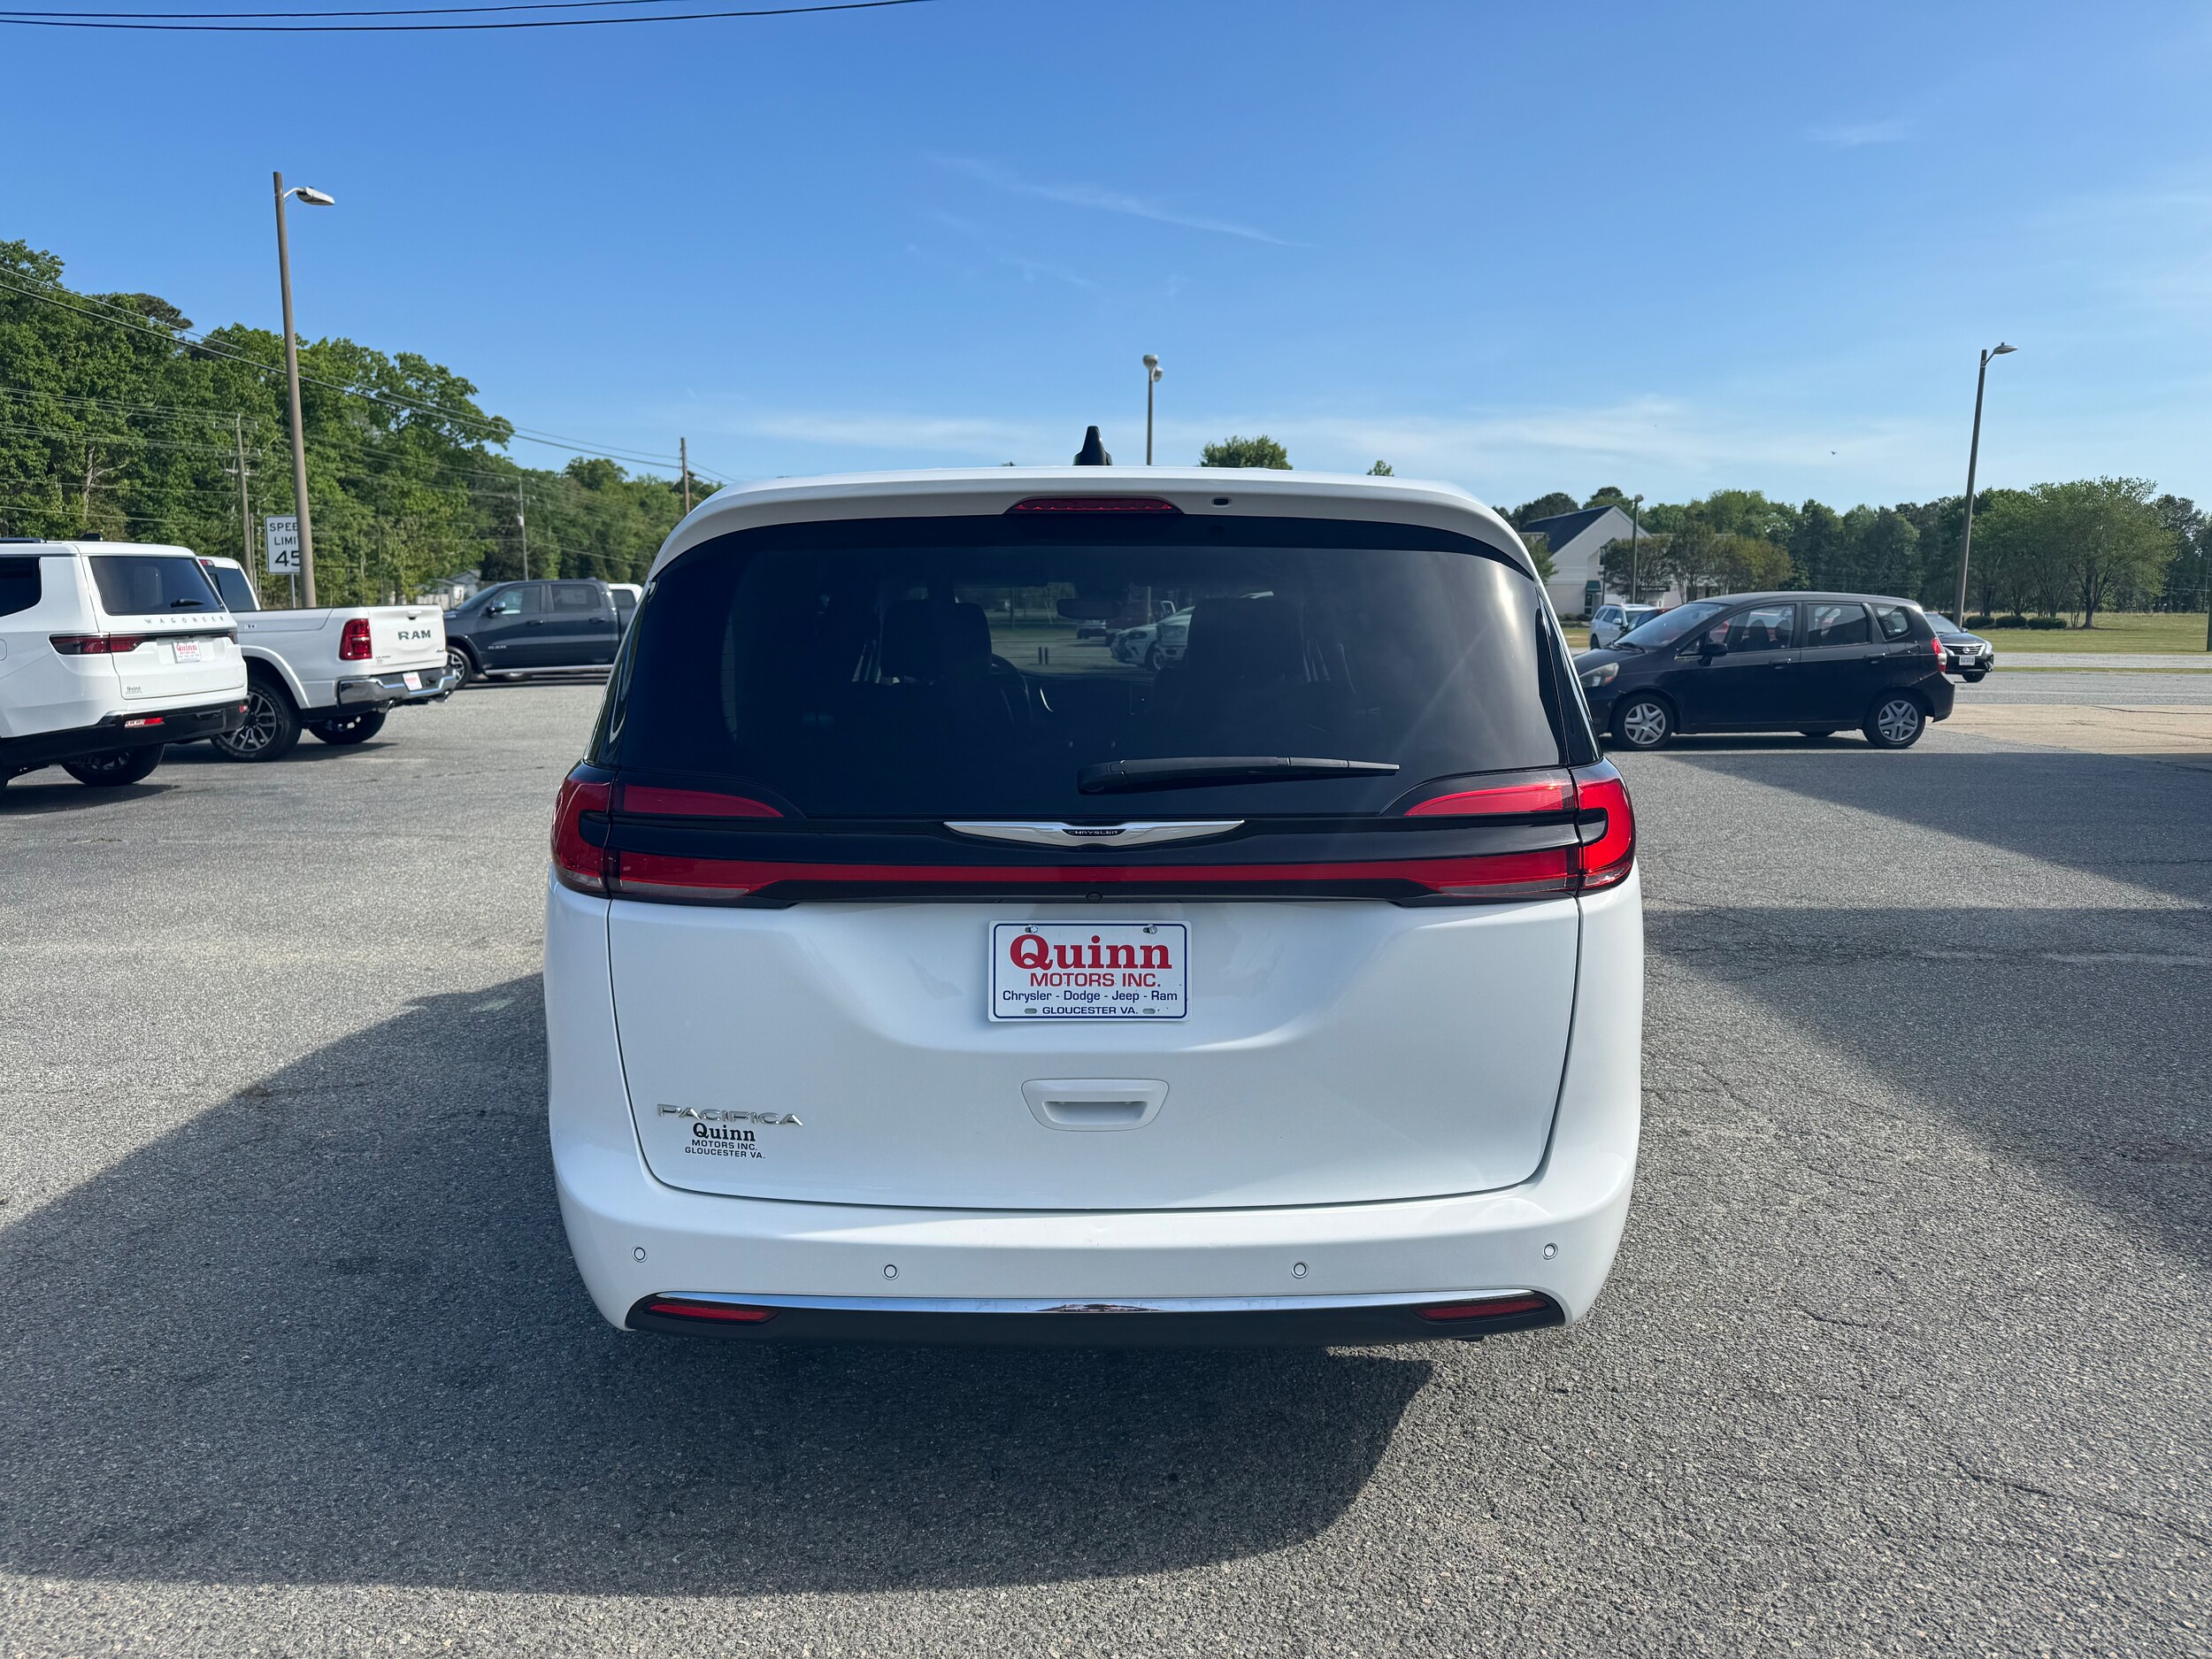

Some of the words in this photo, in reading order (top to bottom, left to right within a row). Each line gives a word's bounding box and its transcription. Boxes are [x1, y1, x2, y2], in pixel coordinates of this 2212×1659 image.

[269, 522, 298, 532] SPEE
[274, 536, 296, 545] LIMI
[275, 550, 300, 567] 45
[144, 616, 224, 625] WAGONEER
[398, 630, 431, 640] RAM
[177, 643, 197, 652] Quinn
[1010, 934, 1172, 970] Quinn
[1030, 972, 1114, 987] MOTORS
[1122, 972, 1161, 987] INC.
[1003, 990, 1052, 1002] Chrysler
[1064, 990, 1100, 1003] Dodge
[1112, 991, 1140, 1002] Jeep
[1151, 991, 1178, 1001] Ram
[1042, 1006, 1116, 1014] GLOUCESTER
[1120, 1006, 1138, 1014] VA.
[657, 1103, 804, 1126] PACIFICA
[693, 1122, 756, 1142] Quinn
[692, 1139, 734, 1149] MOTORS
[737, 1142, 757, 1151] INC.
[685, 1147, 747, 1158] GLOUCESTER
